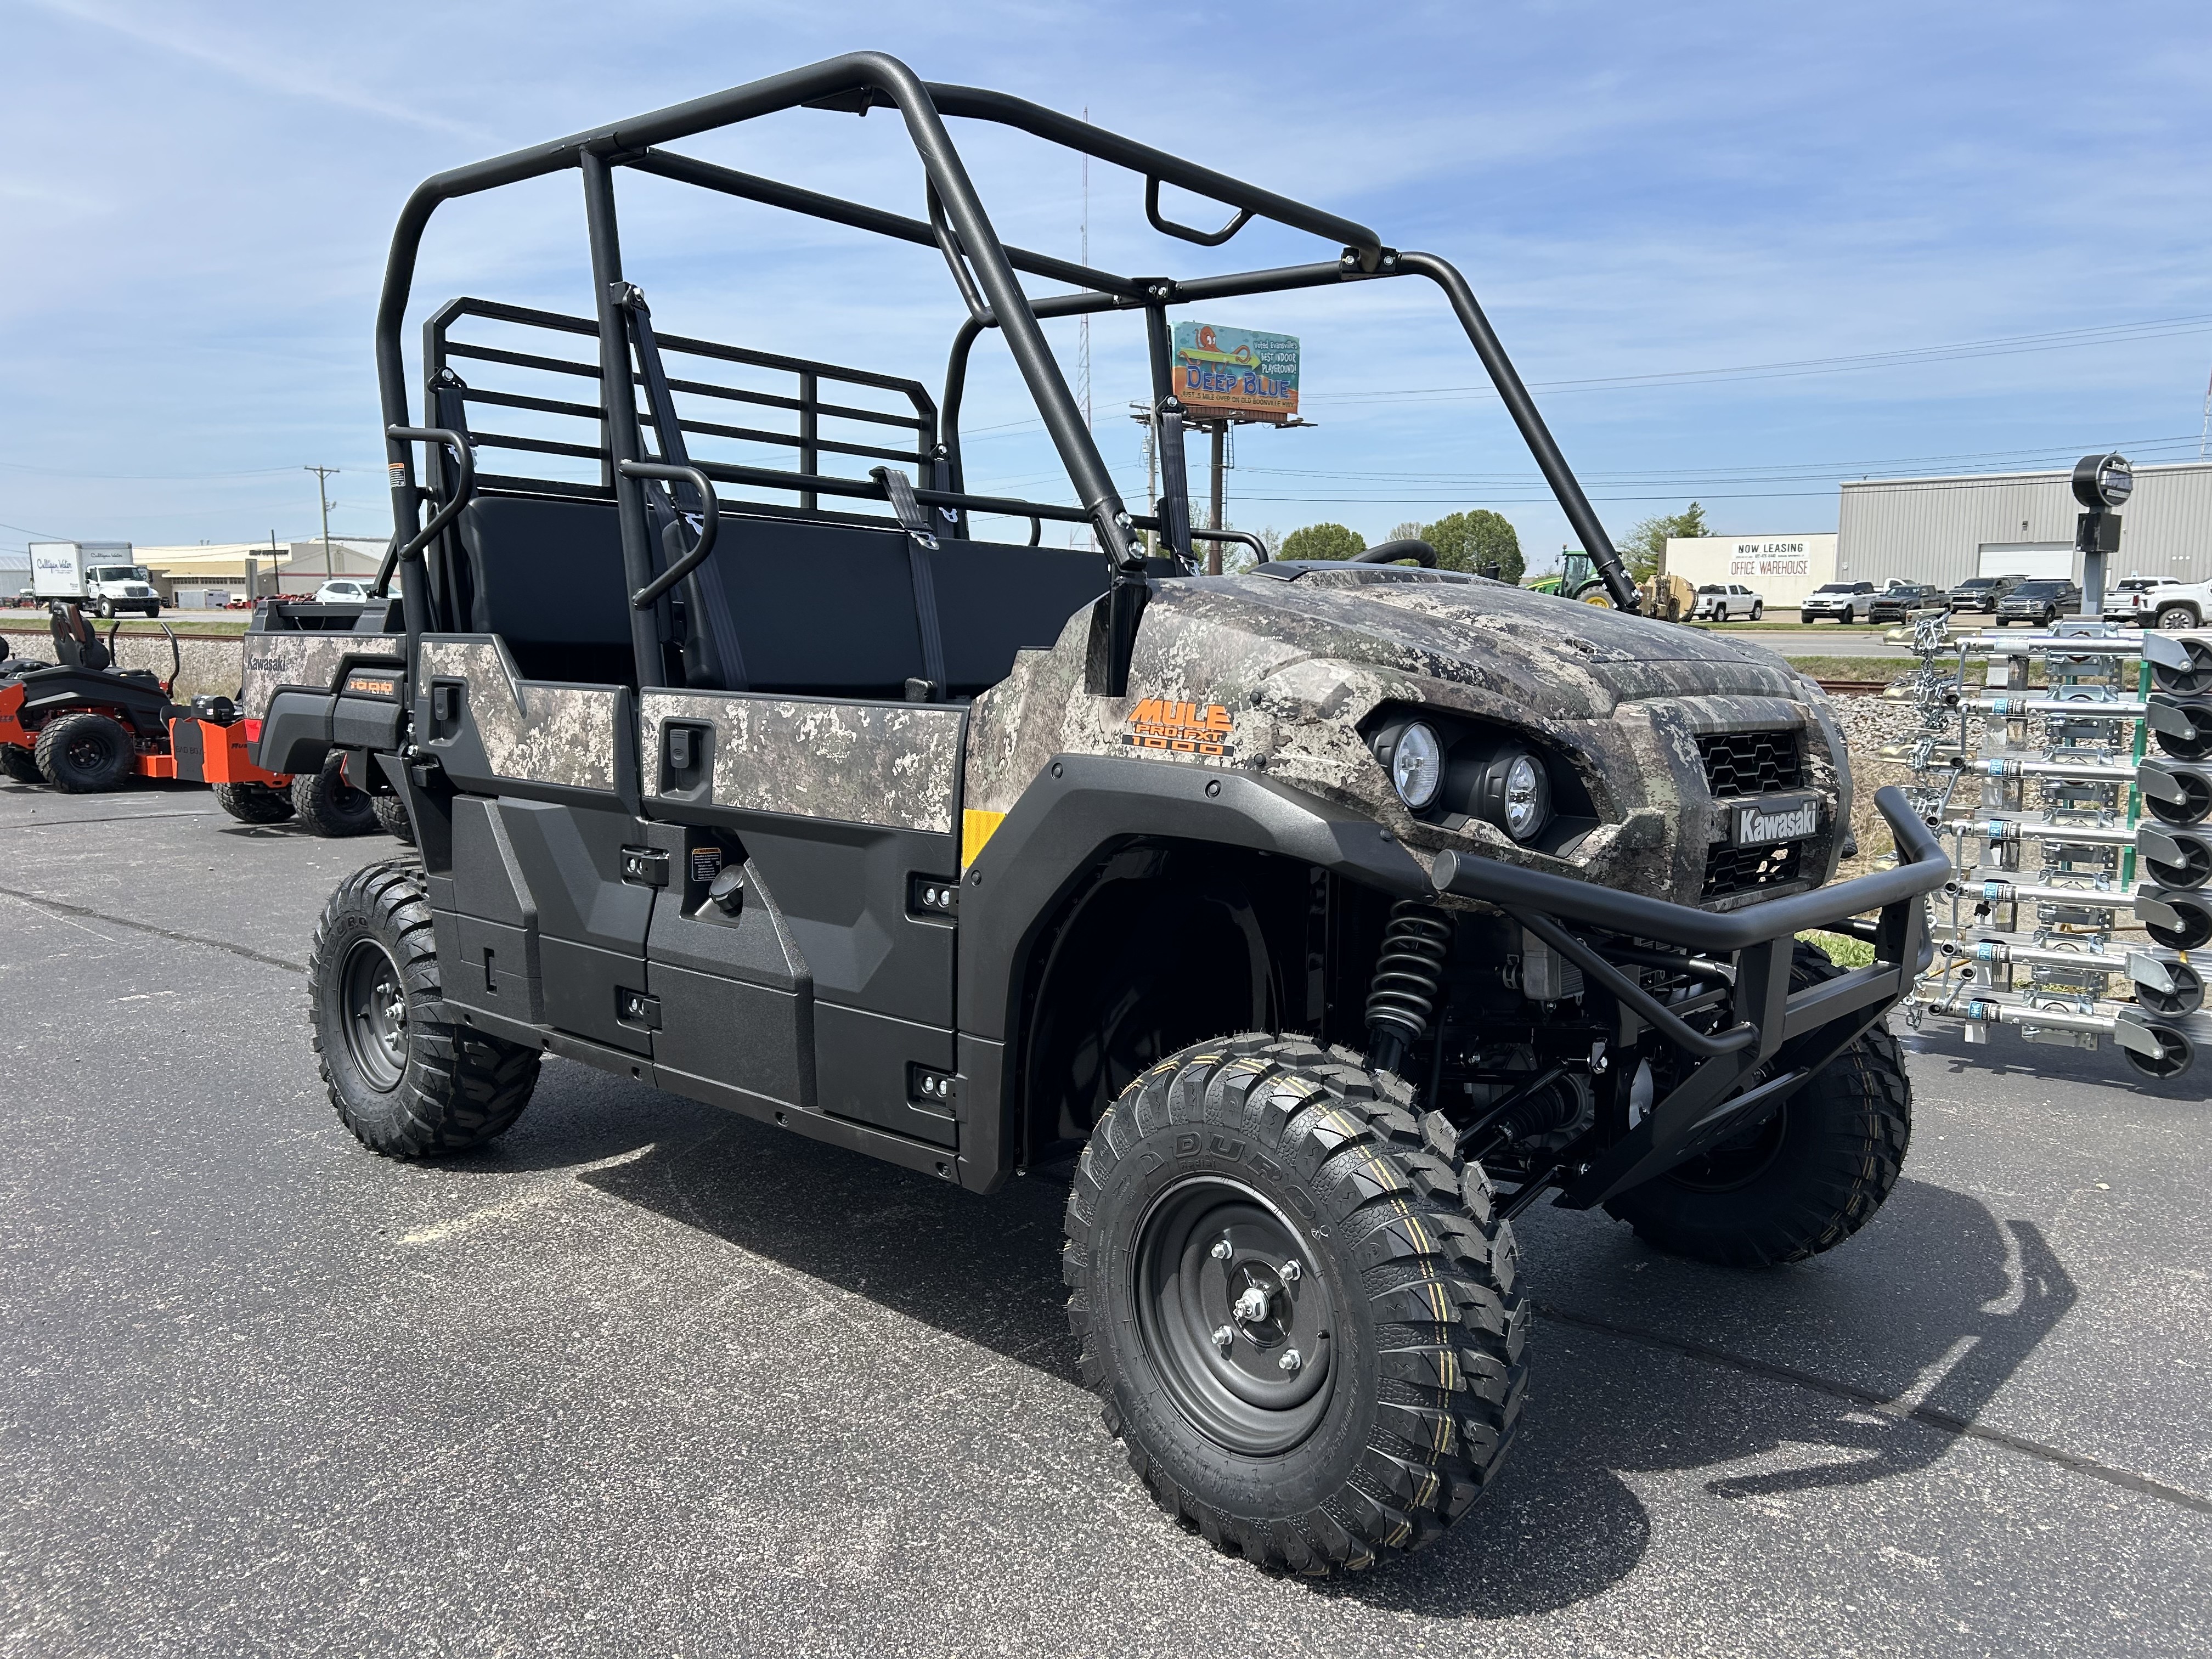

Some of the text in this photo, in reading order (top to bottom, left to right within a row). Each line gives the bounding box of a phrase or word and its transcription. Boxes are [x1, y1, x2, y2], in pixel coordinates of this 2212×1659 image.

[1254, 340, 1269, 349] Voted
[1261, 352, 1296, 363] BEST INDOOR
[1262, 364, 1297, 374] PLAYGROUND!
[1187, 365, 1290, 398] DEEP BLUE
[1253, 398, 1280, 407] BOONVILLE
[1738, 543, 1803, 554] NOW LEASING
[37, 558, 59, 574] Culligan
[1731, 560, 1808, 575] OFFICE WAREHOUSE
[247, 654, 286, 672] Kawasaki
[1127, 698, 1234, 732] MULE
[1132, 736, 1224, 755] 1000
[1740, 802, 1816, 844] Kawasaki
[1985, 884, 1996, 900] PRO
[1979, 944, 1990, 961] PRO
[1971, 1003, 1981, 1019] PRO
[1175, 1131, 1316, 1220] DURO
